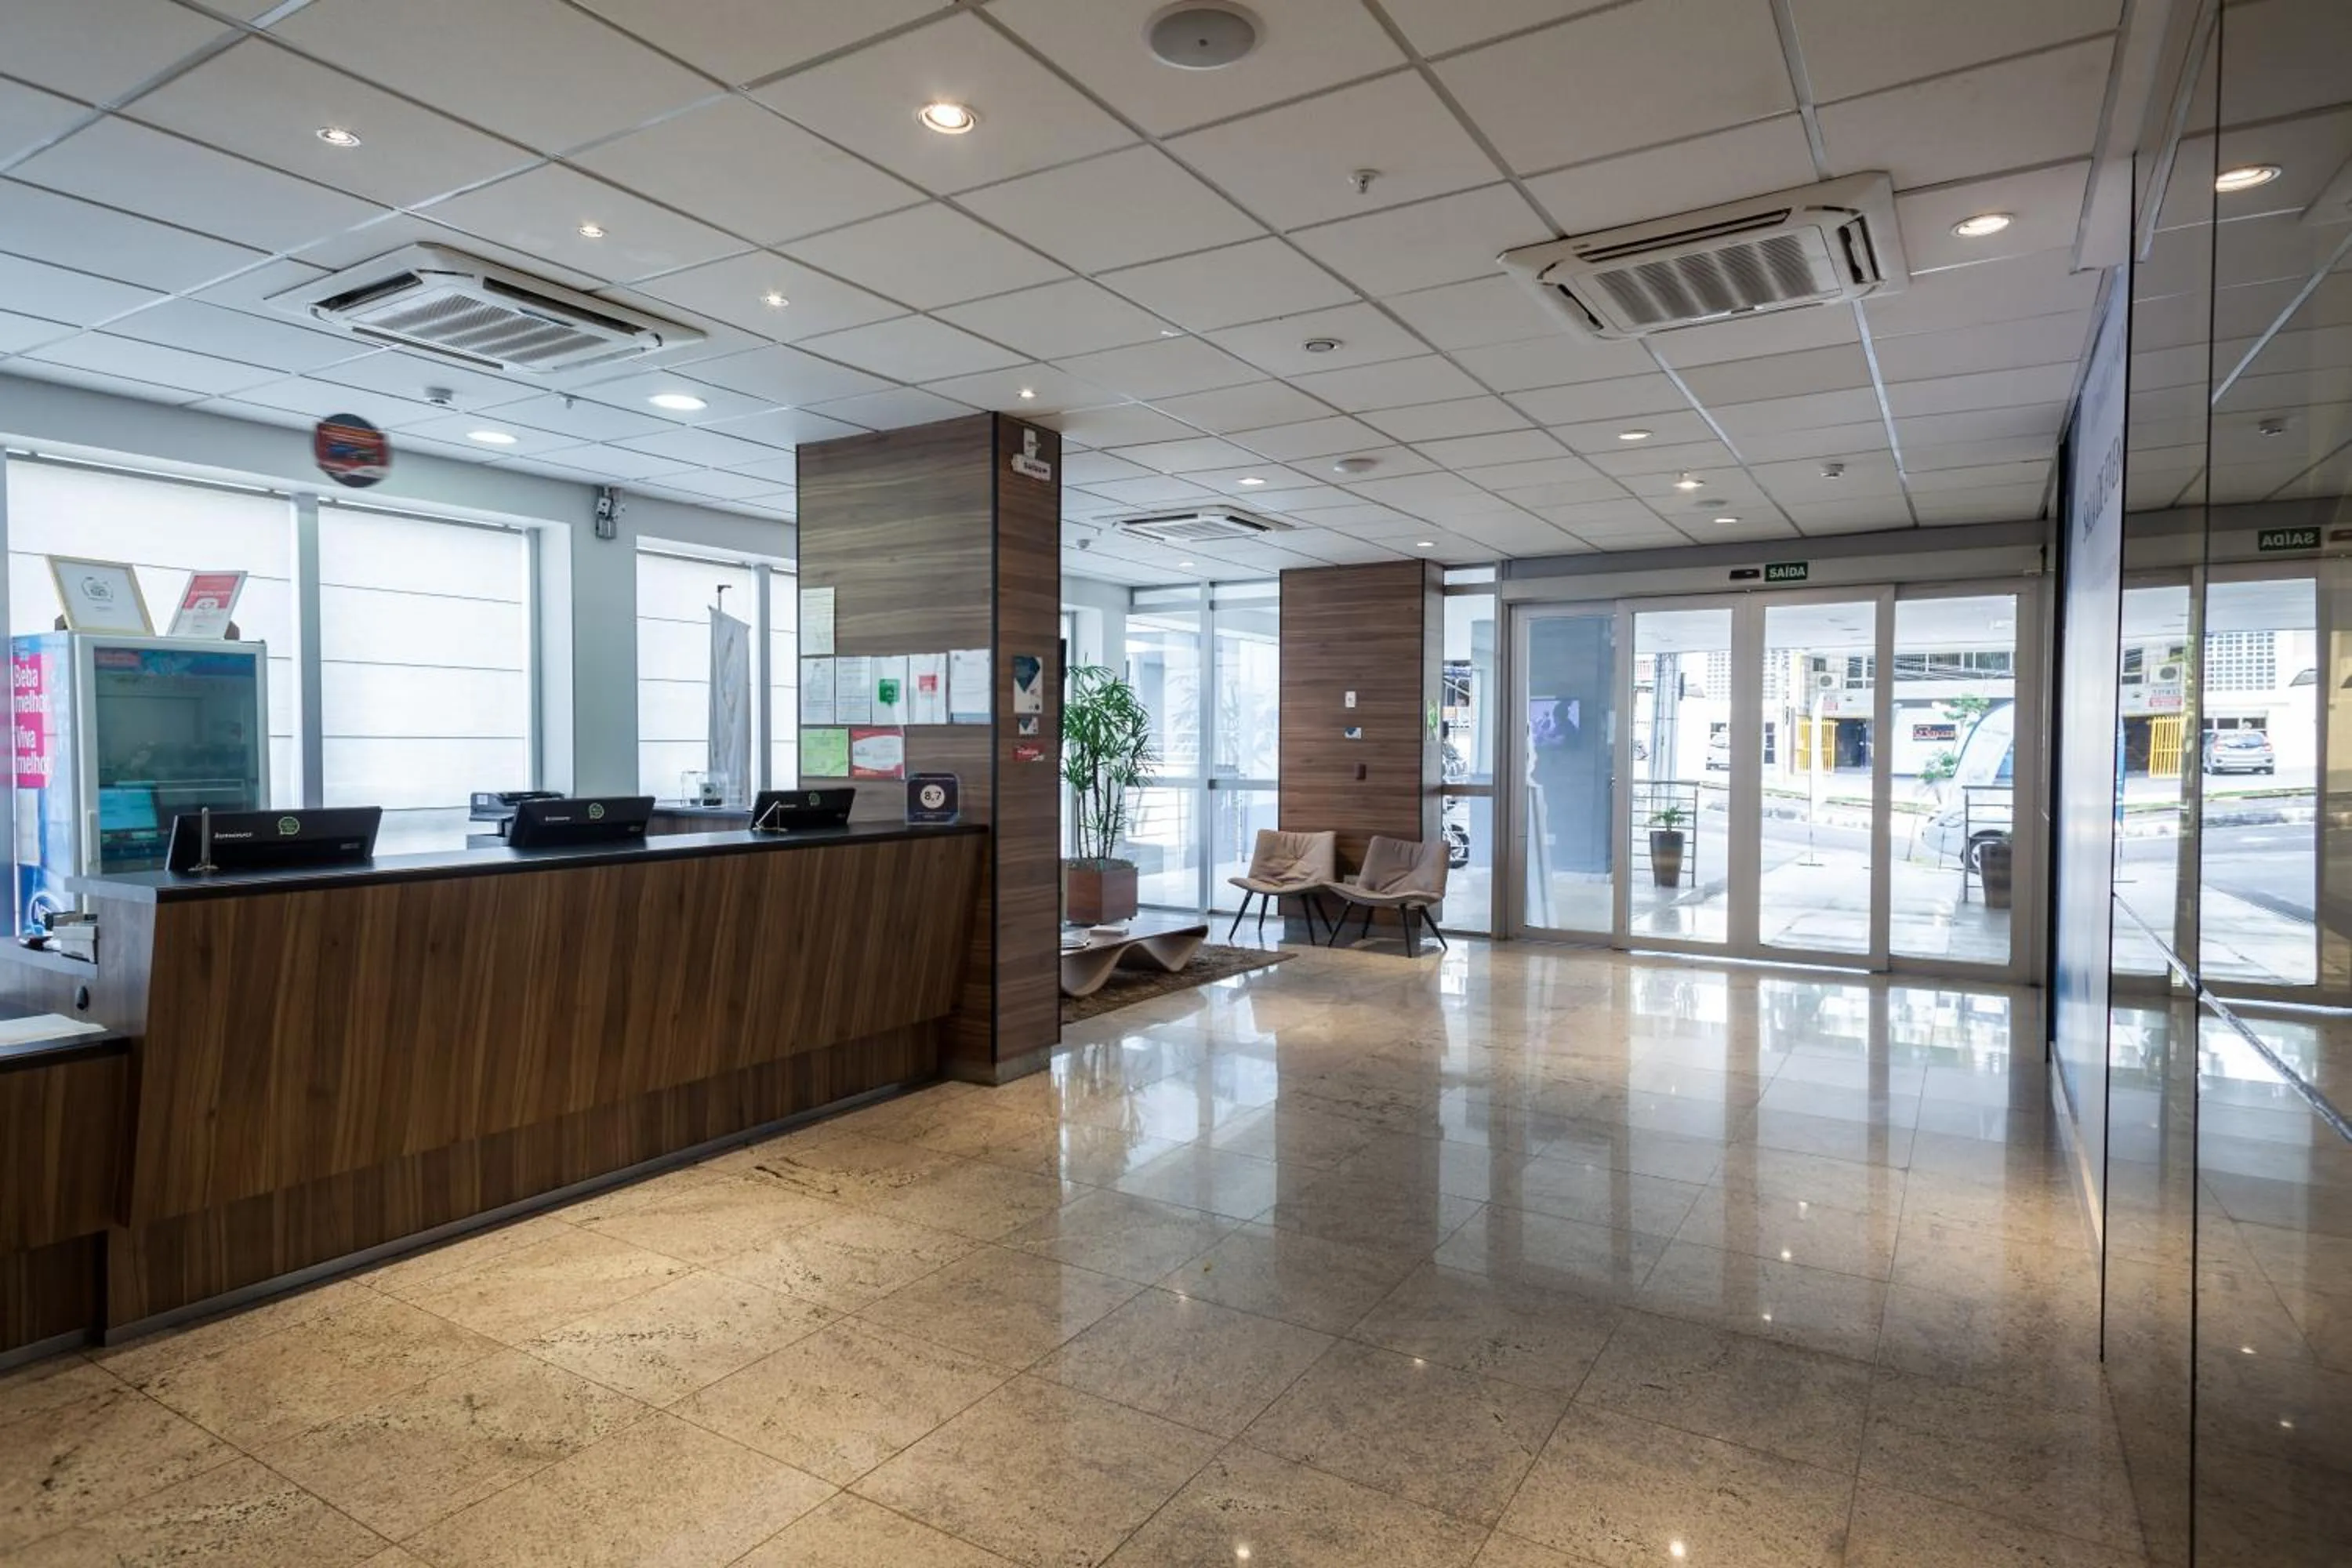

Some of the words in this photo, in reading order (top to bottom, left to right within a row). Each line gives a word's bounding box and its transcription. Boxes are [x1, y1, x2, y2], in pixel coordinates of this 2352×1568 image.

[1769, 564, 1806, 578] SAÍDA
[13, 665, 38, 688] Beba
[15, 725, 37, 749] Viva
